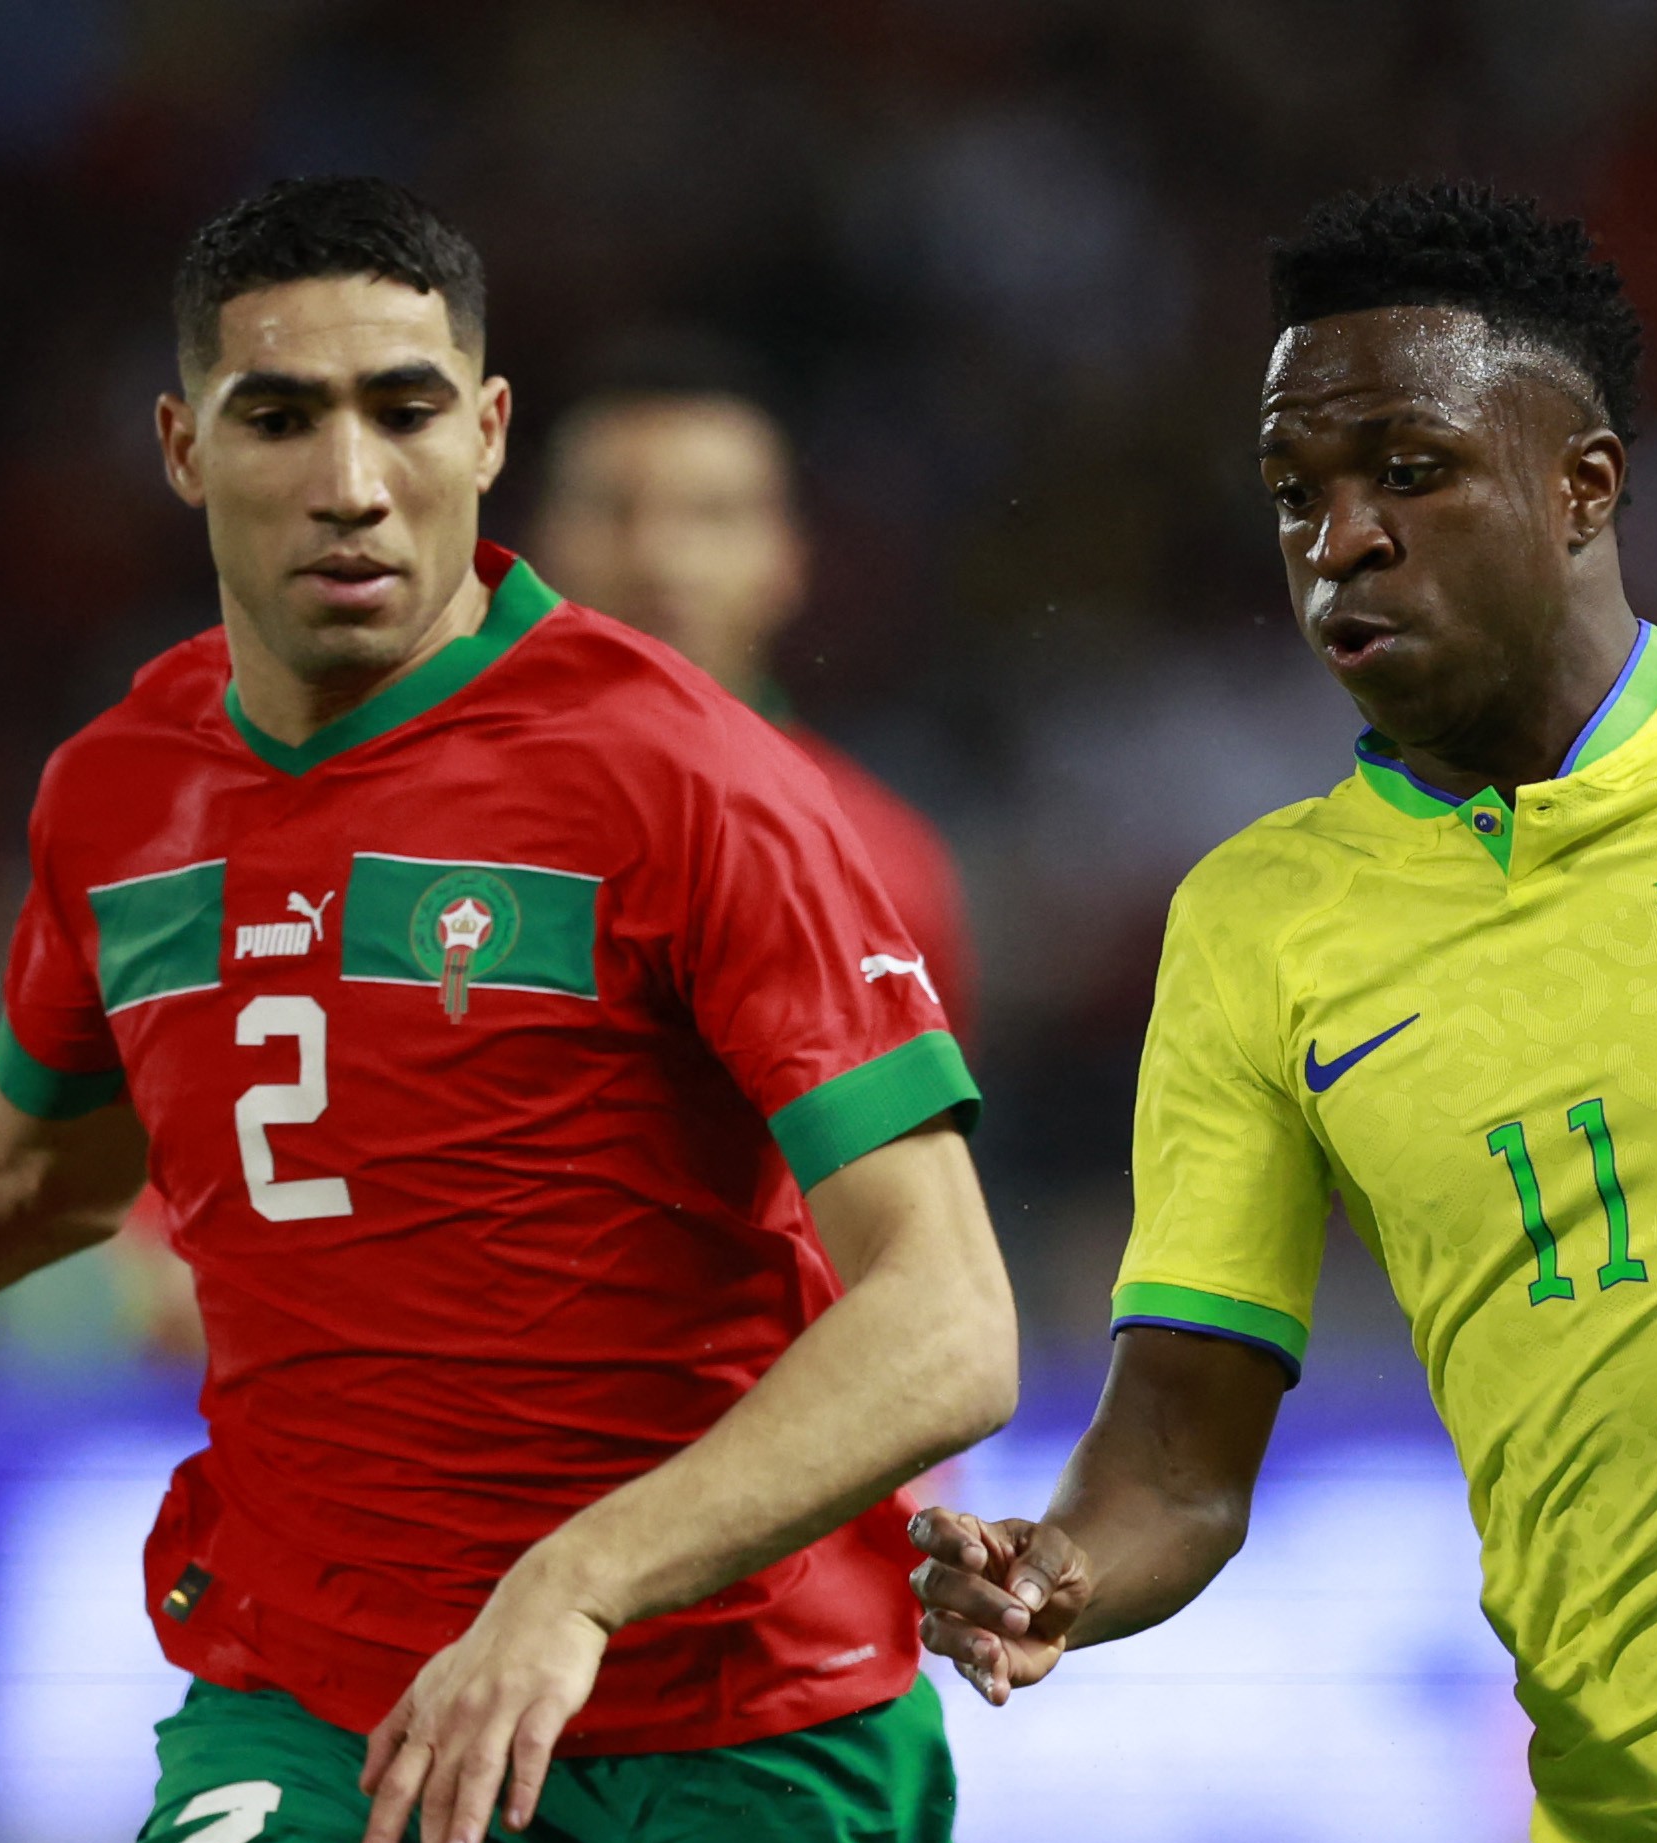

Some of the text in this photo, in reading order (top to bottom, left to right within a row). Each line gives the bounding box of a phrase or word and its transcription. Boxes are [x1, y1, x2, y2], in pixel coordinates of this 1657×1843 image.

[234, 922, 312, 960] PUMA
[234, 994, 354, 1223] 2
[1486, 1097, 1650, 1308] 11
